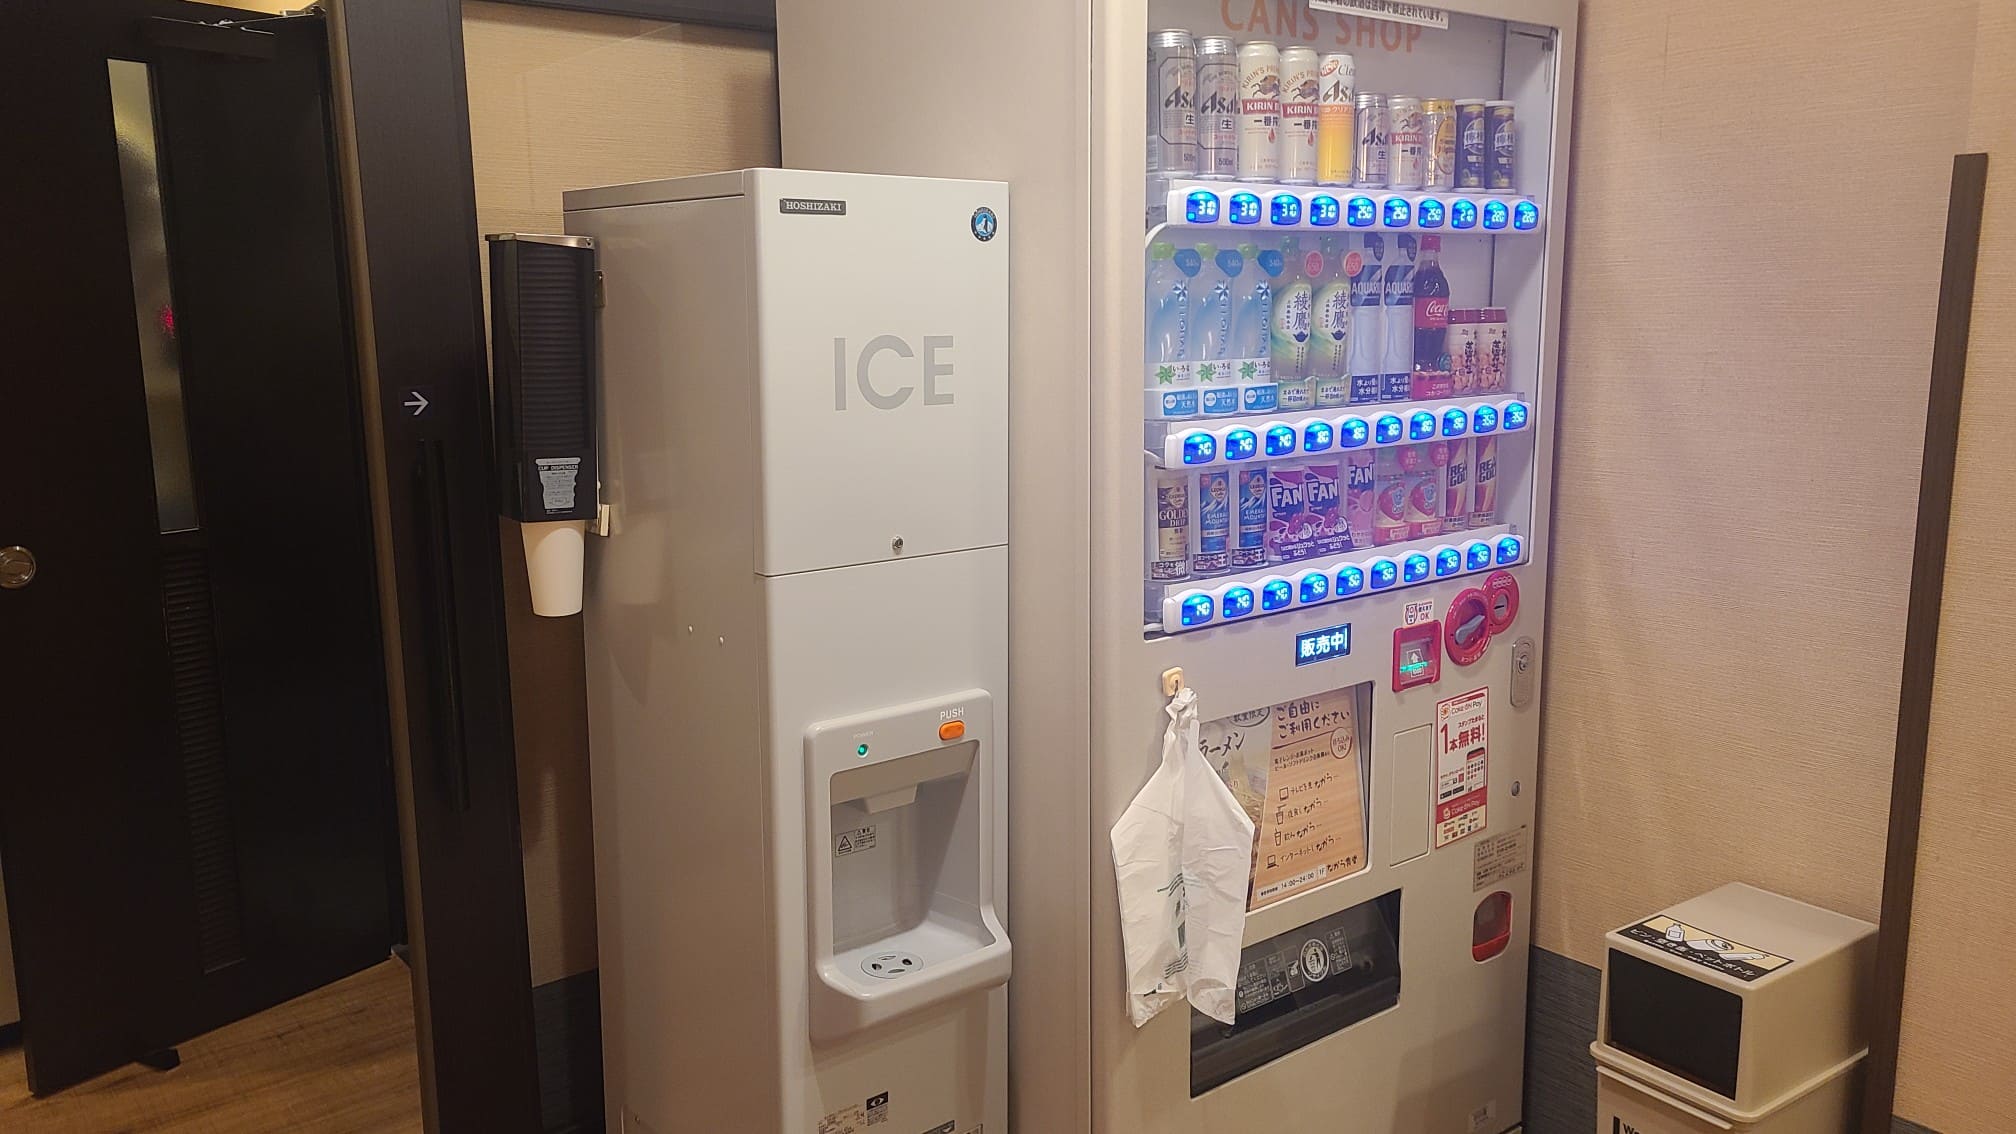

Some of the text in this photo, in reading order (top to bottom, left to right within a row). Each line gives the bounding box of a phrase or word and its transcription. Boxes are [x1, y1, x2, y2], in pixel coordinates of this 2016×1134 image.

[1221, 0, 1421, 52] CANS SHOP
[1247, 101, 1274, 111] KIRIN
[1287, 105, 1313, 115] KIRIN
[1221, 119, 1233, 129] 生
[786, 202, 841, 211] HOSHIZAKI
[1293, 290, 1309, 330] 綾鷹
[1331, 289, 1348, 329] 綾鷹
[834, 335, 954, 411] ICE
[1420, 612, 1430, 621] OK
[1301, 632, 1344, 658] 販売中
[940, 707, 964, 720] PUSH
[1276, 700, 1320, 721] ご自由に
[1279, 711, 1350, 738] ご利用ください
